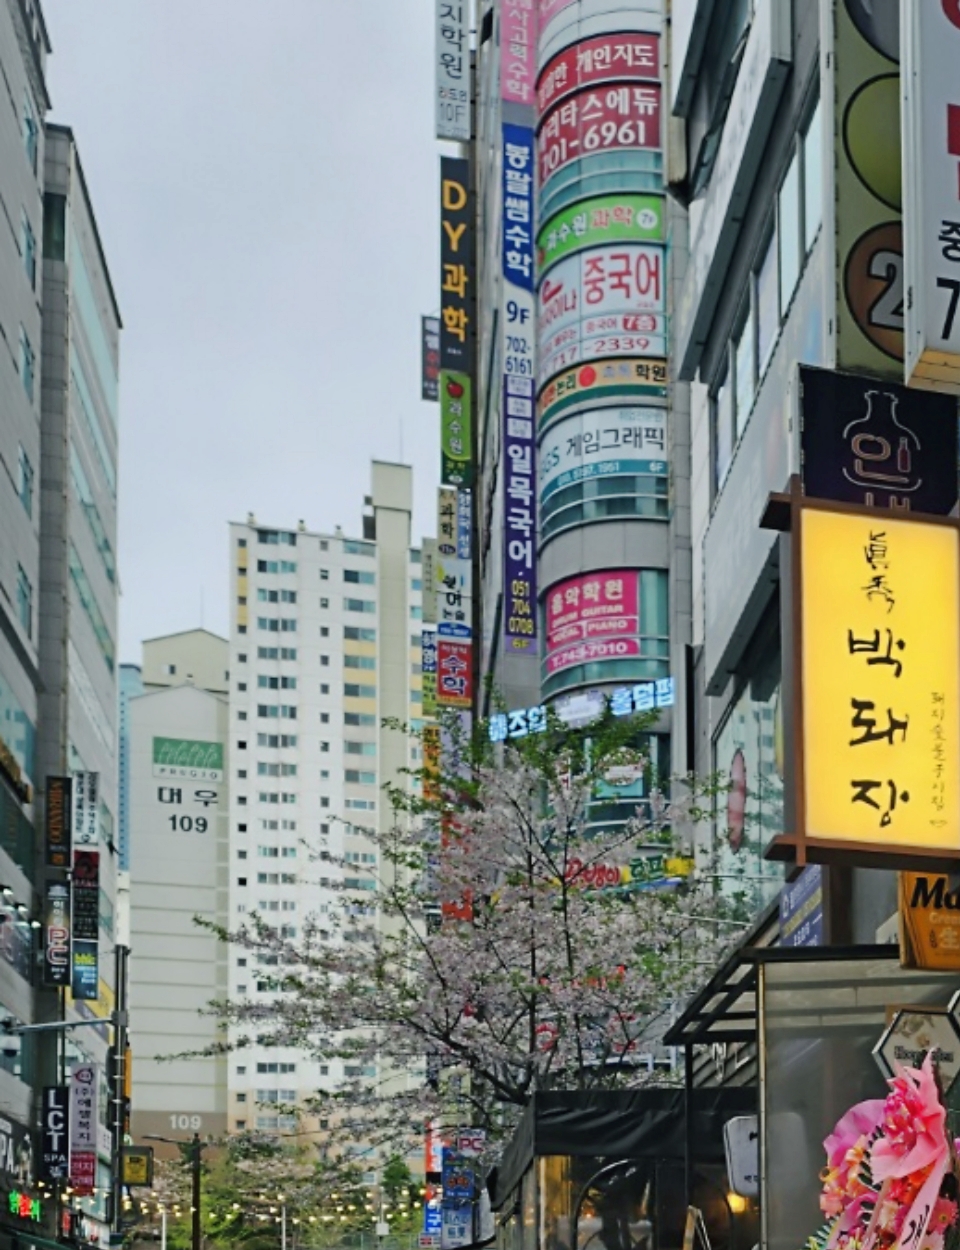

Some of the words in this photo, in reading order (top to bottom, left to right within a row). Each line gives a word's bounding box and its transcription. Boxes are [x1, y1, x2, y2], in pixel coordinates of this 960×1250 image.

[576, 44, 655, 73] 개인지도
[583, 253, 661, 305] 중국어
[506, 301, 531, 325] 9F
[566, 427, 664, 457] 게임그래픽
[158, 786, 218, 807] 대우
[169, 814, 208, 833] 109
[47, 1090, 65, 1151] LCT
[170, 1115, 202, 1129] 109
[44, 1154, 66, 1162] SPA
